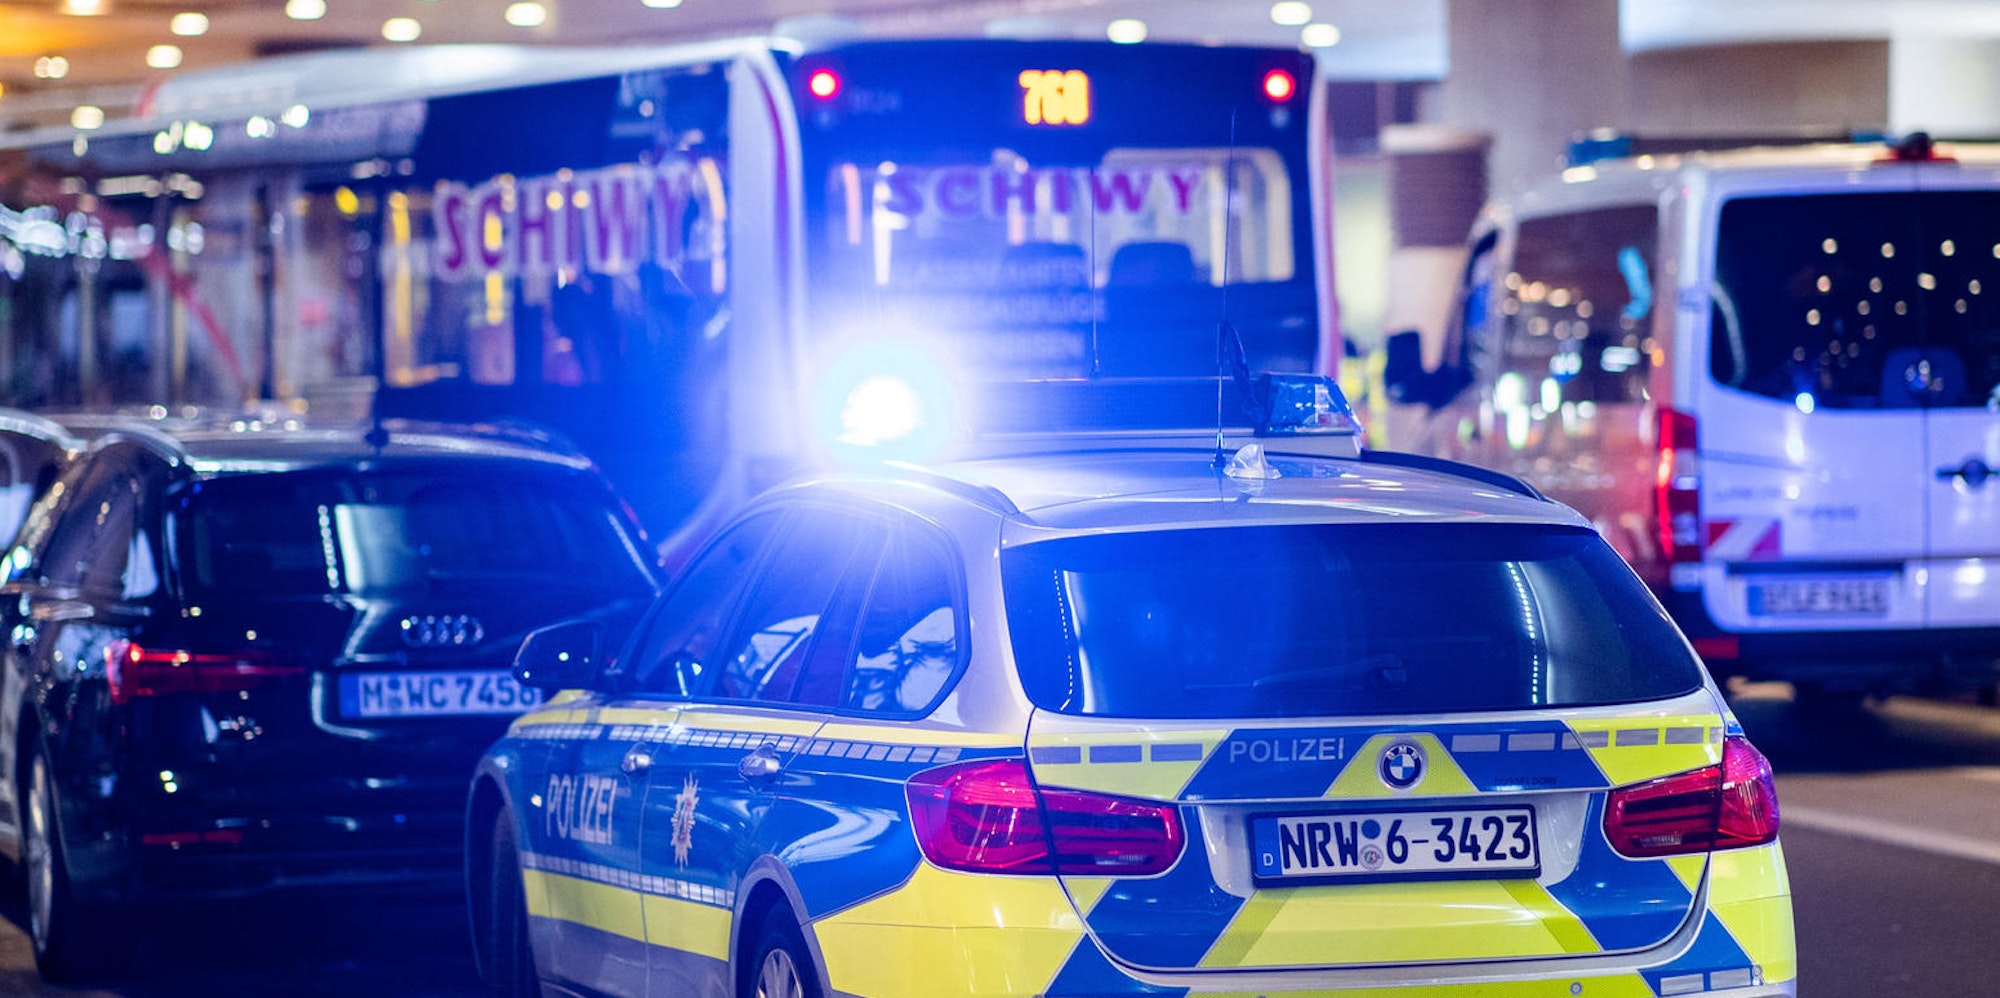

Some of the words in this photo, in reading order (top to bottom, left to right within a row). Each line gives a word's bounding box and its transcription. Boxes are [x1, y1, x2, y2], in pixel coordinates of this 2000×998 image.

[438, 162, 691, 273] SCHIWY
[880, 168, 1202, 217] SCHIWY
[362, 679, 383, 708] M
[406, 676, 447, 708] WC
[1229, 737, 1345, 763] POLIZEI
[546, 773, 618, 846] POLIZEI
[1263, 852, 1274, 866] D
[1280, 820, 1359, 869] NRW
[1386, 815, 1531, 864] 6-3423
